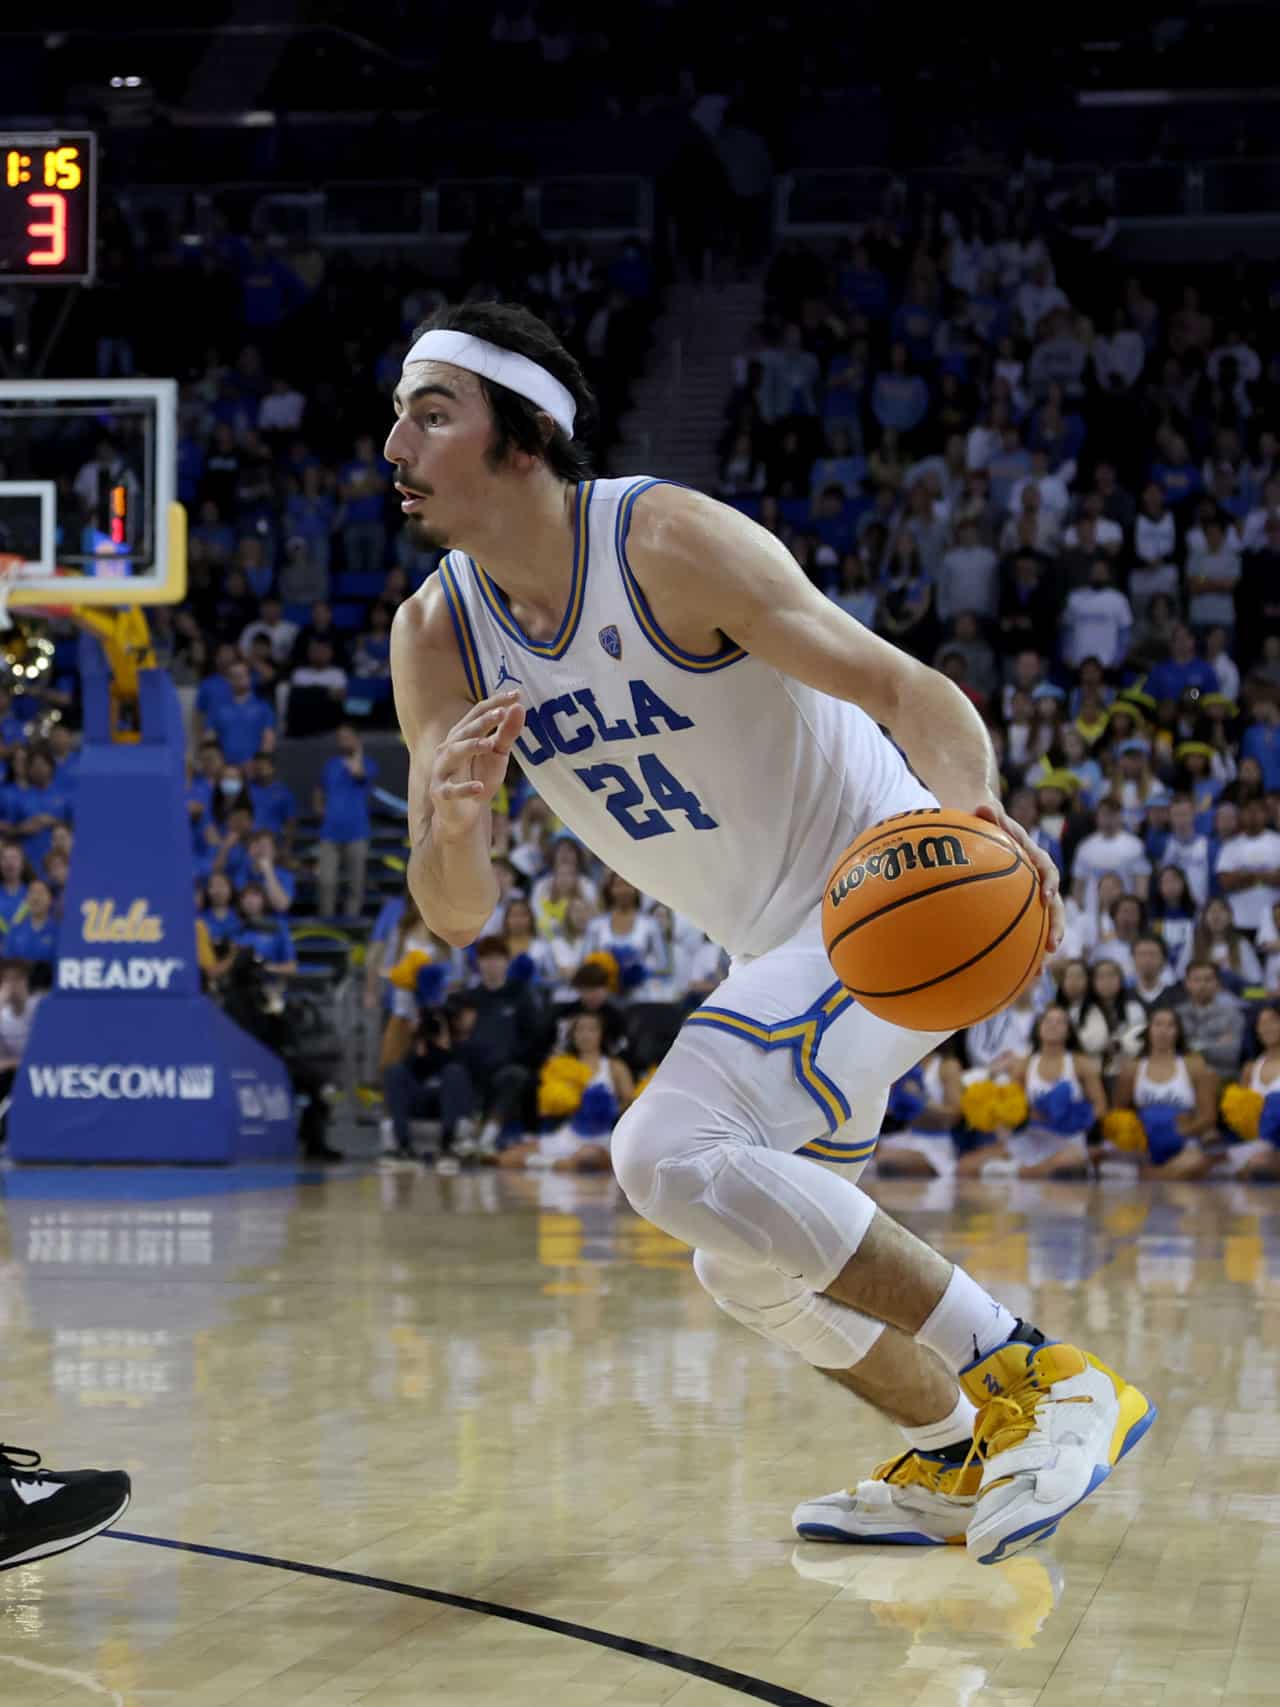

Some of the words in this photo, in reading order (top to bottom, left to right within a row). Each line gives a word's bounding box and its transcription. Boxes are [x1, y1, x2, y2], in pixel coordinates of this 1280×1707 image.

[7, 146, 81, 190] 1:15
[27, 193, 66, 265] 3
[516, 680, 695, 766] UCLA
[573, 753, 719, 840] 24
[830, 834, 970, 907] Wilson
[58, 957, 177, 989] READY
[28, 1064, 176, 1099] WESCOM
